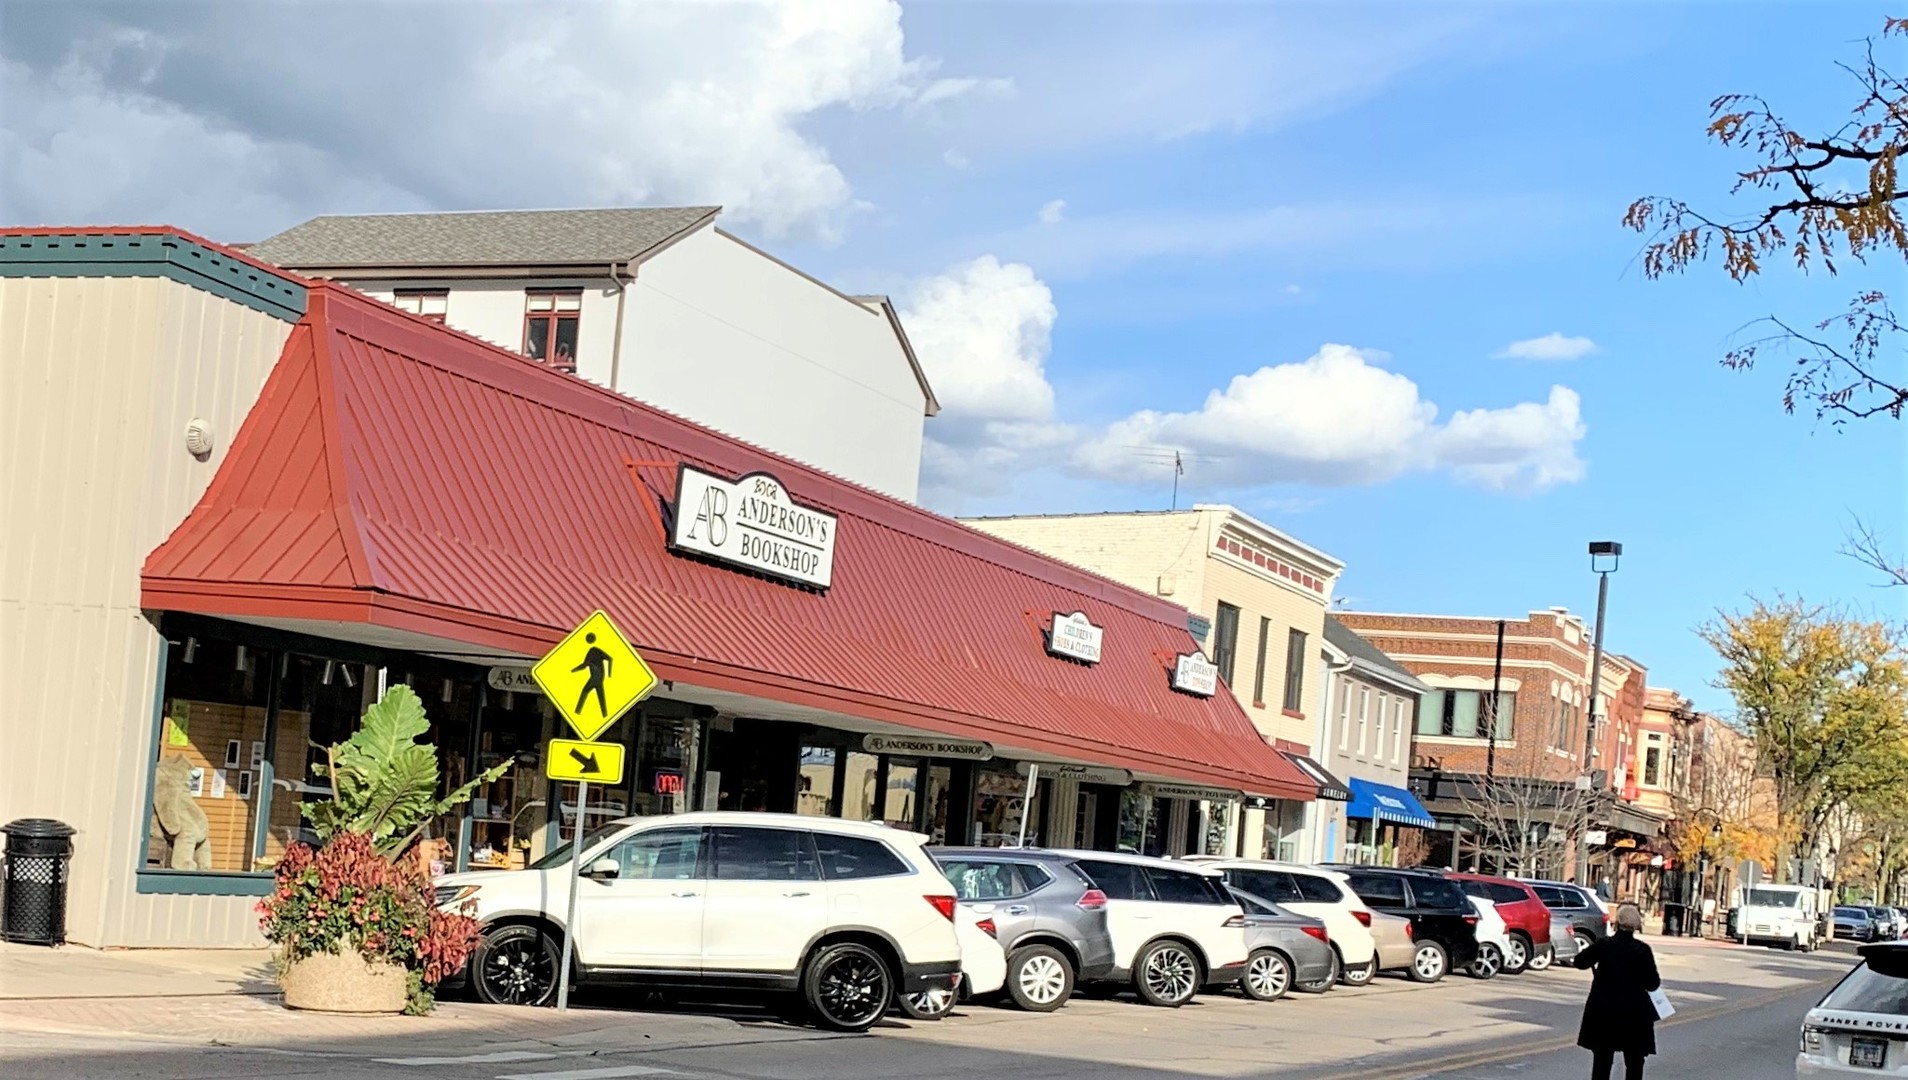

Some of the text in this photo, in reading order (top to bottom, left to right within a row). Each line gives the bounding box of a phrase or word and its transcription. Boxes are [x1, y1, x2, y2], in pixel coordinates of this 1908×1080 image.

[737, 496, 828, 543] ANDERSON'S
[741, 533, 819, 576] BOOKSHOP
[885, 740, 935, 751] ANDERSON'S
[937, 744, 983, 755] BOOKSHOP
[658, 775, 684, 793] OPEN
[1068, 772, 1106, 782] CLOTHING
[1157, 786, 1203, 796] ANDERSON'S
